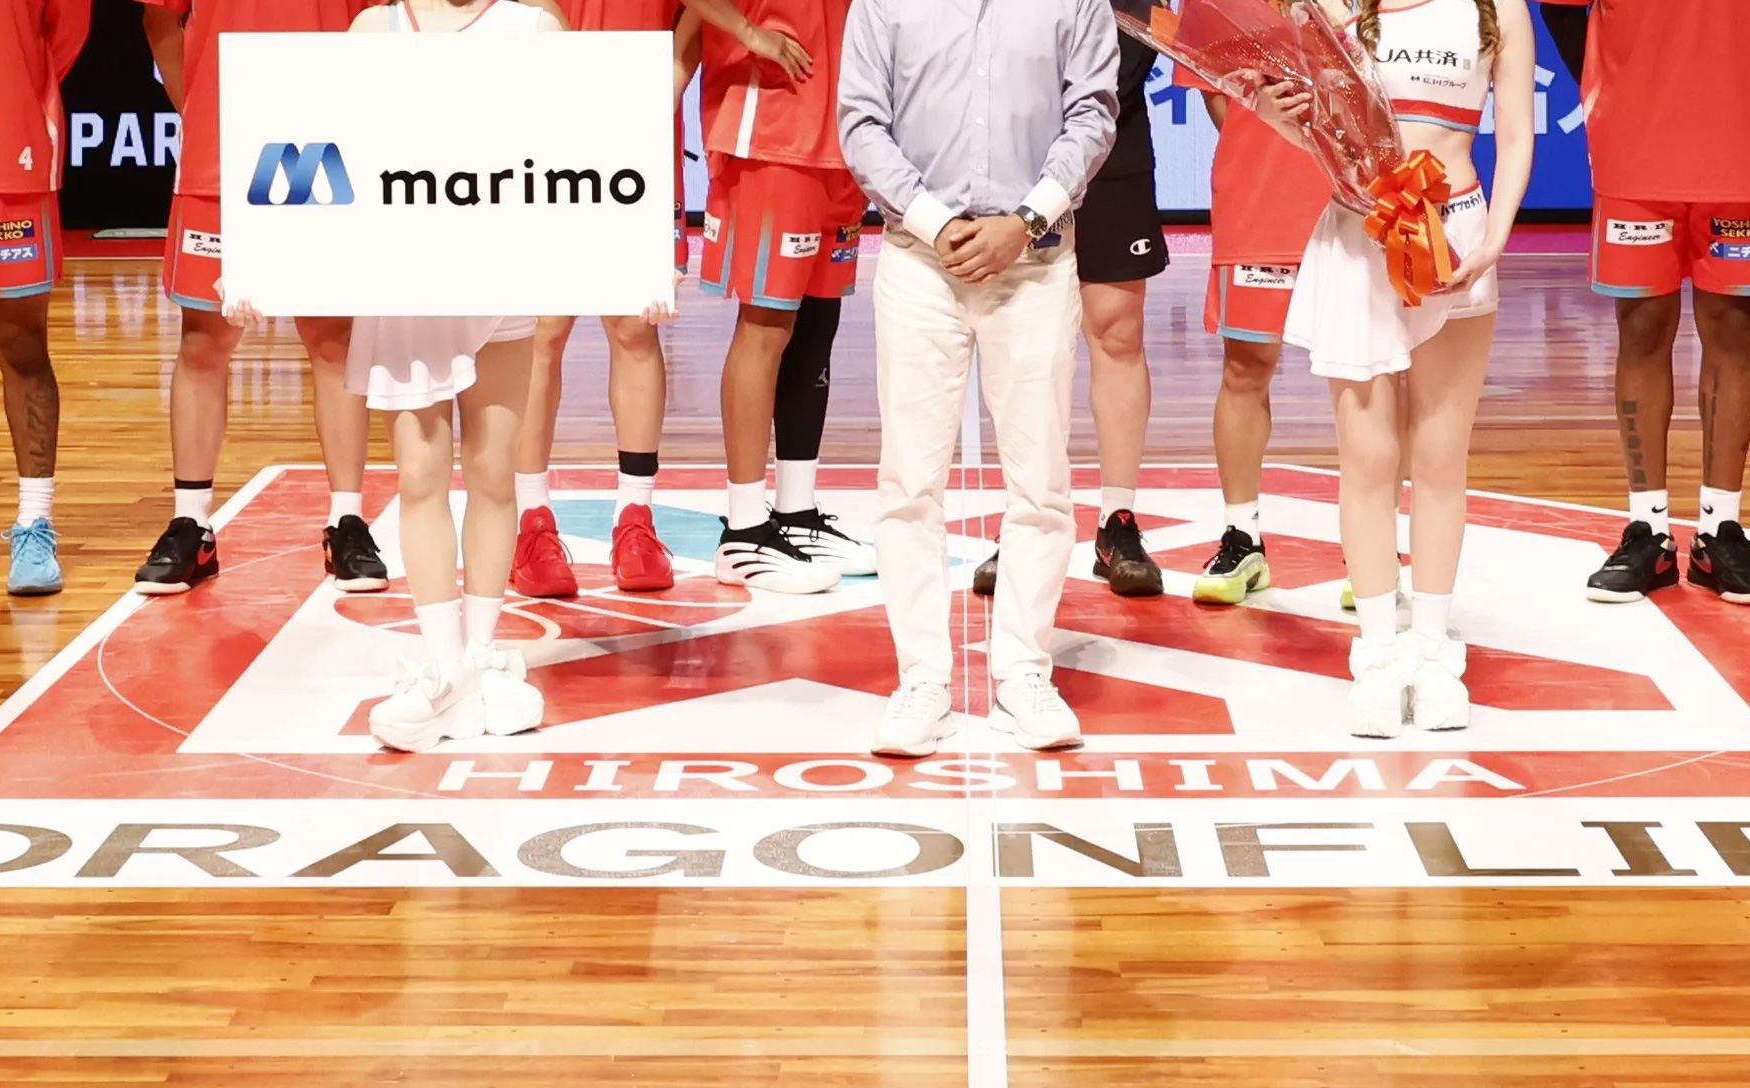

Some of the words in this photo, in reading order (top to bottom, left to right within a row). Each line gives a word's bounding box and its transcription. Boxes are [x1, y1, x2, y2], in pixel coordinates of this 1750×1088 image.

[1375, 48, 1460, 69] JA共済
[18, 146, 34, 171] 4
[379, 158, 646, 207] marimo
[437, 756, 1528, 794] HIROSHIMA
